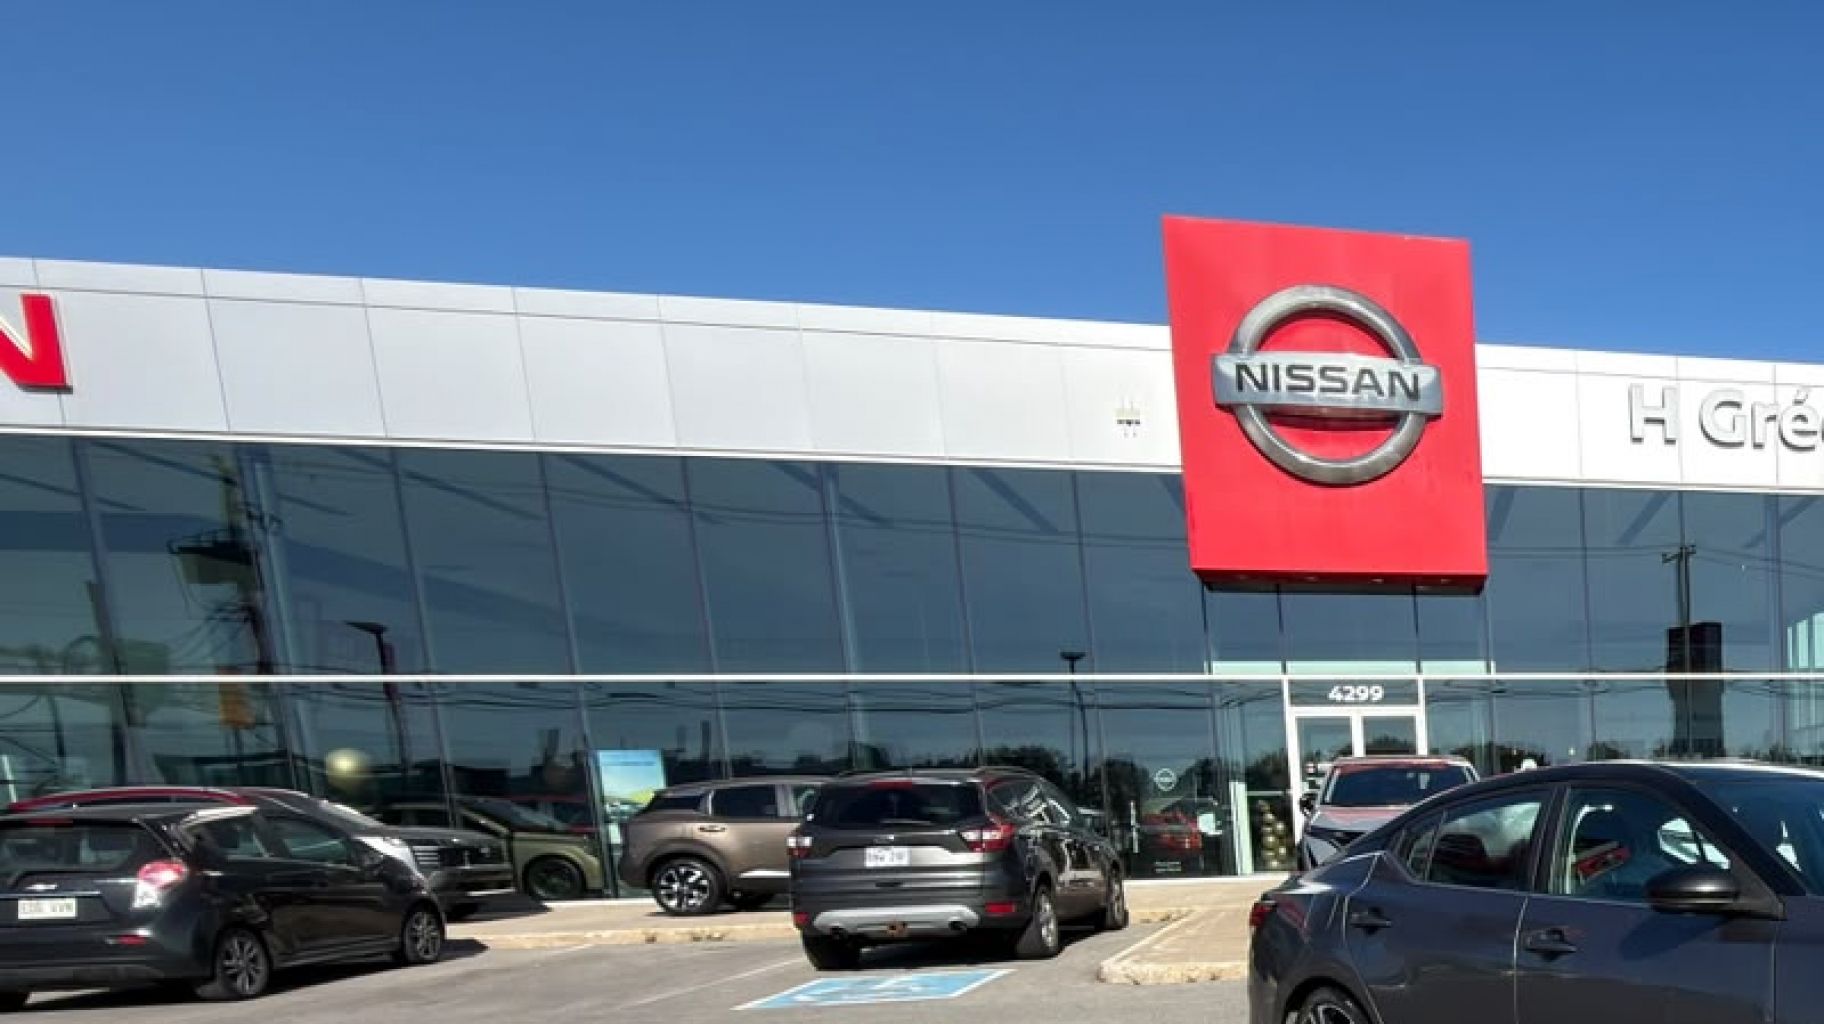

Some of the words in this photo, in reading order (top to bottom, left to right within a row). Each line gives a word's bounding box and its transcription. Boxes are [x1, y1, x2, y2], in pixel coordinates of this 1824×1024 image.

[1235, 362, 1421, 402] NISSAN
[1628, 383, 1679, 446] H
[1328, 685, 1384, 702] 4299
